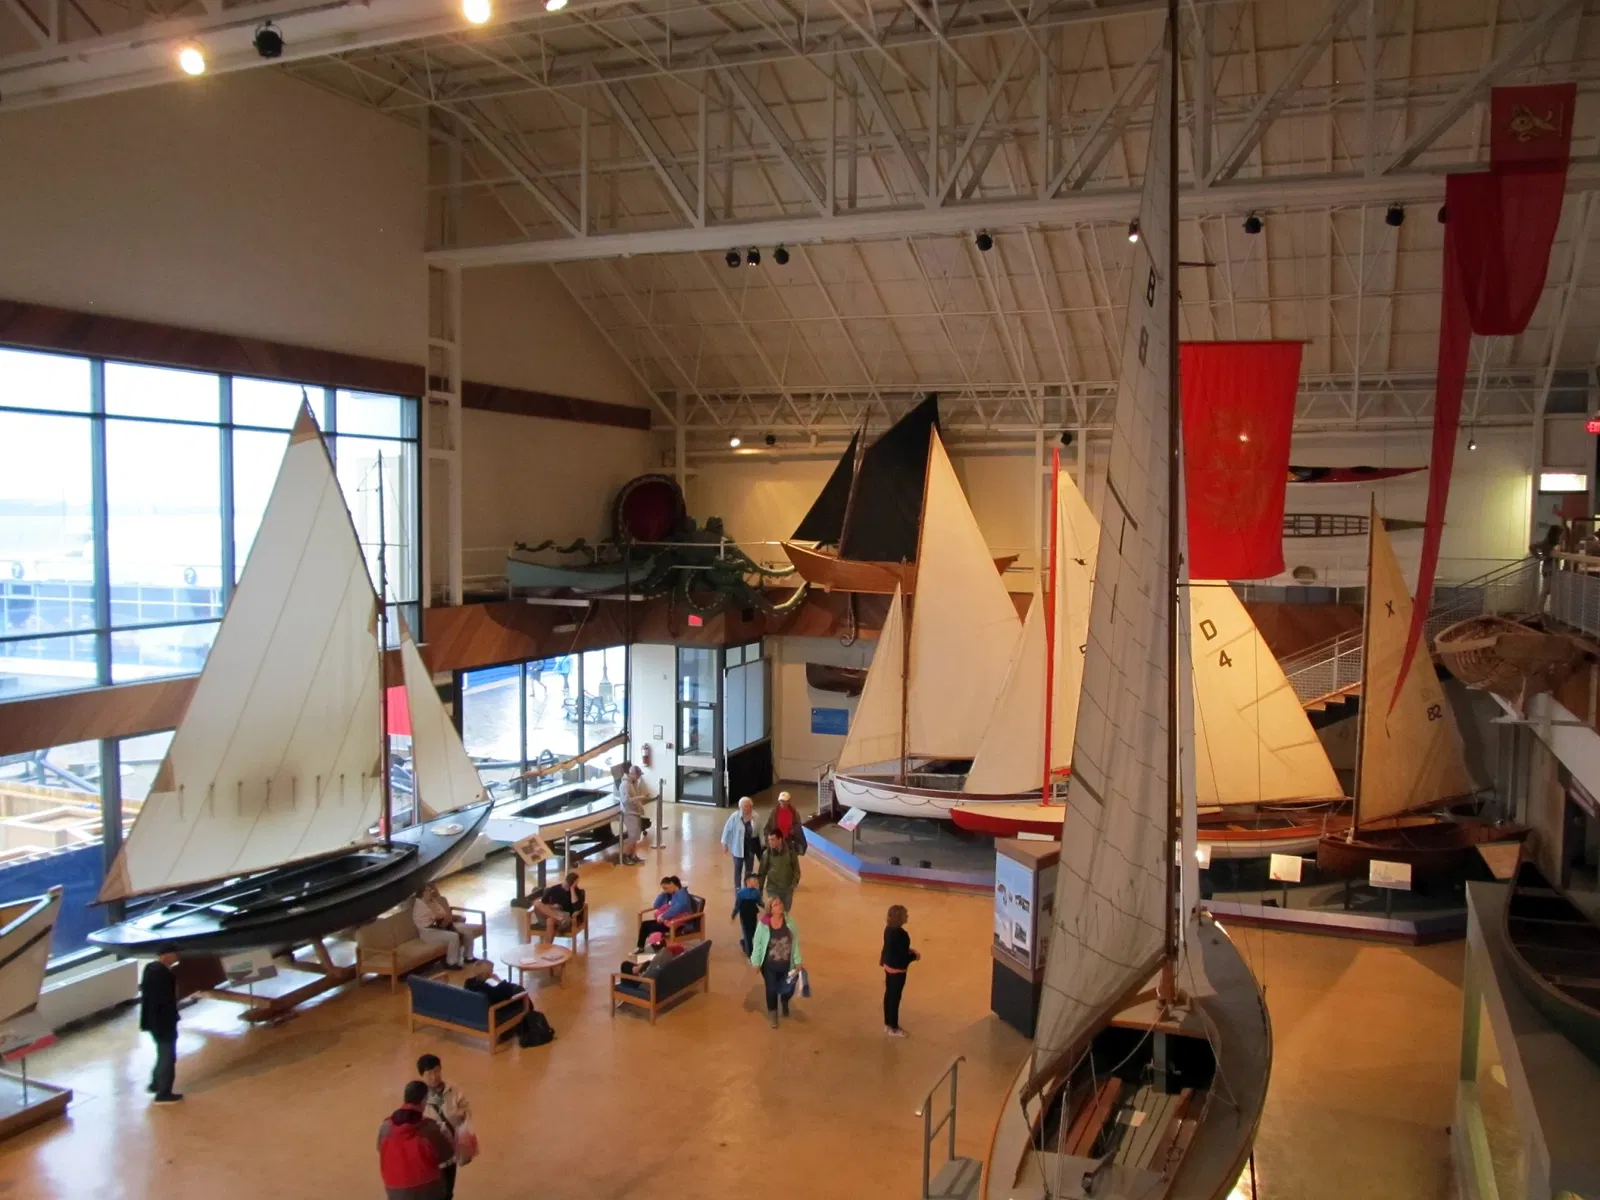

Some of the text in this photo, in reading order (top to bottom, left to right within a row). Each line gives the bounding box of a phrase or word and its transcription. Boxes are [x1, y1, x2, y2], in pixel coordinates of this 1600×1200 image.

[1385, 600, 1395, 618] X
[1199, 619, 1218, 641] D
[1219, 649, 1232, 668] 4
[1427, 704, 1442, 721] 82
